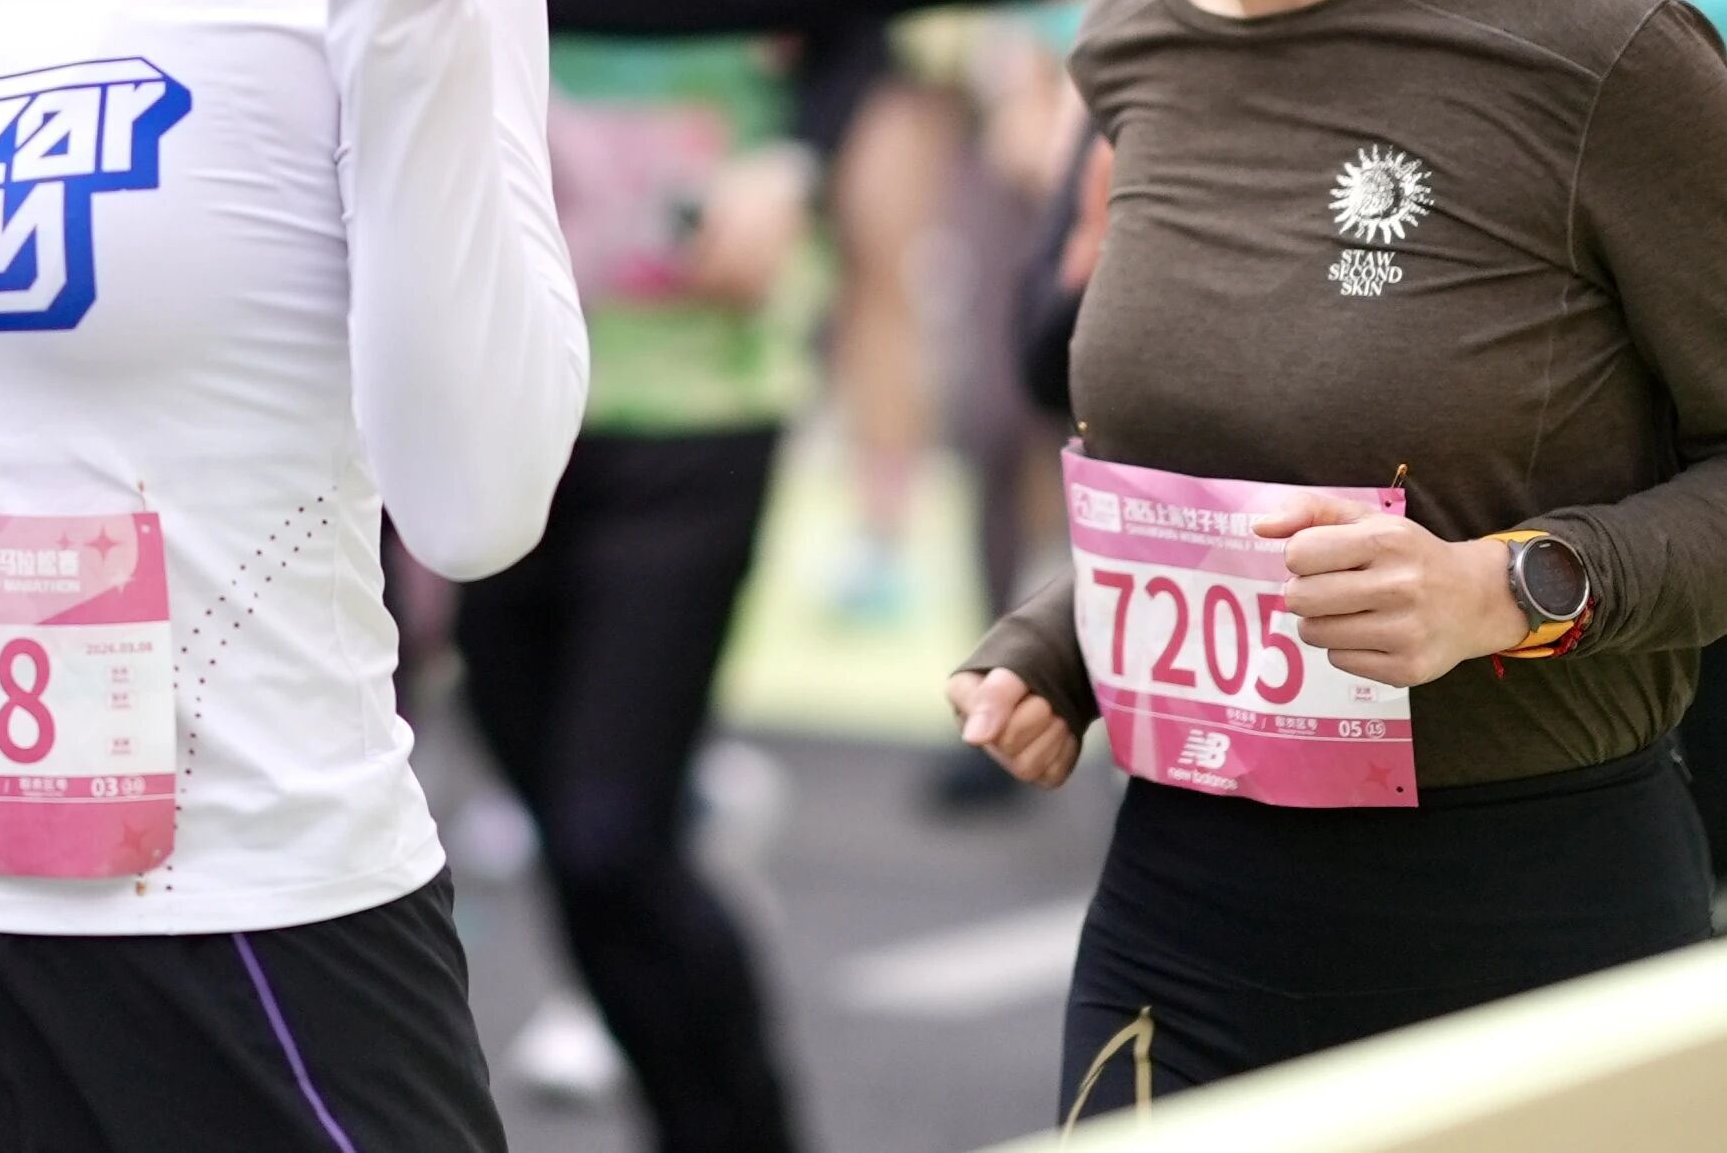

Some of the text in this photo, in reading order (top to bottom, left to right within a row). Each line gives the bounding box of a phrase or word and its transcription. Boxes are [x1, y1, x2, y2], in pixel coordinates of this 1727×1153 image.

[1341, 249, 1395, 266] STAW
[1328, 264, 1403, 283] SECOND
[1340, 280, 1384, 296] SKIN
[1092, 568, 1305, 705] 7205
[1338, 720, 1362, 737] 05
[91, 776, 118, 798] 03
